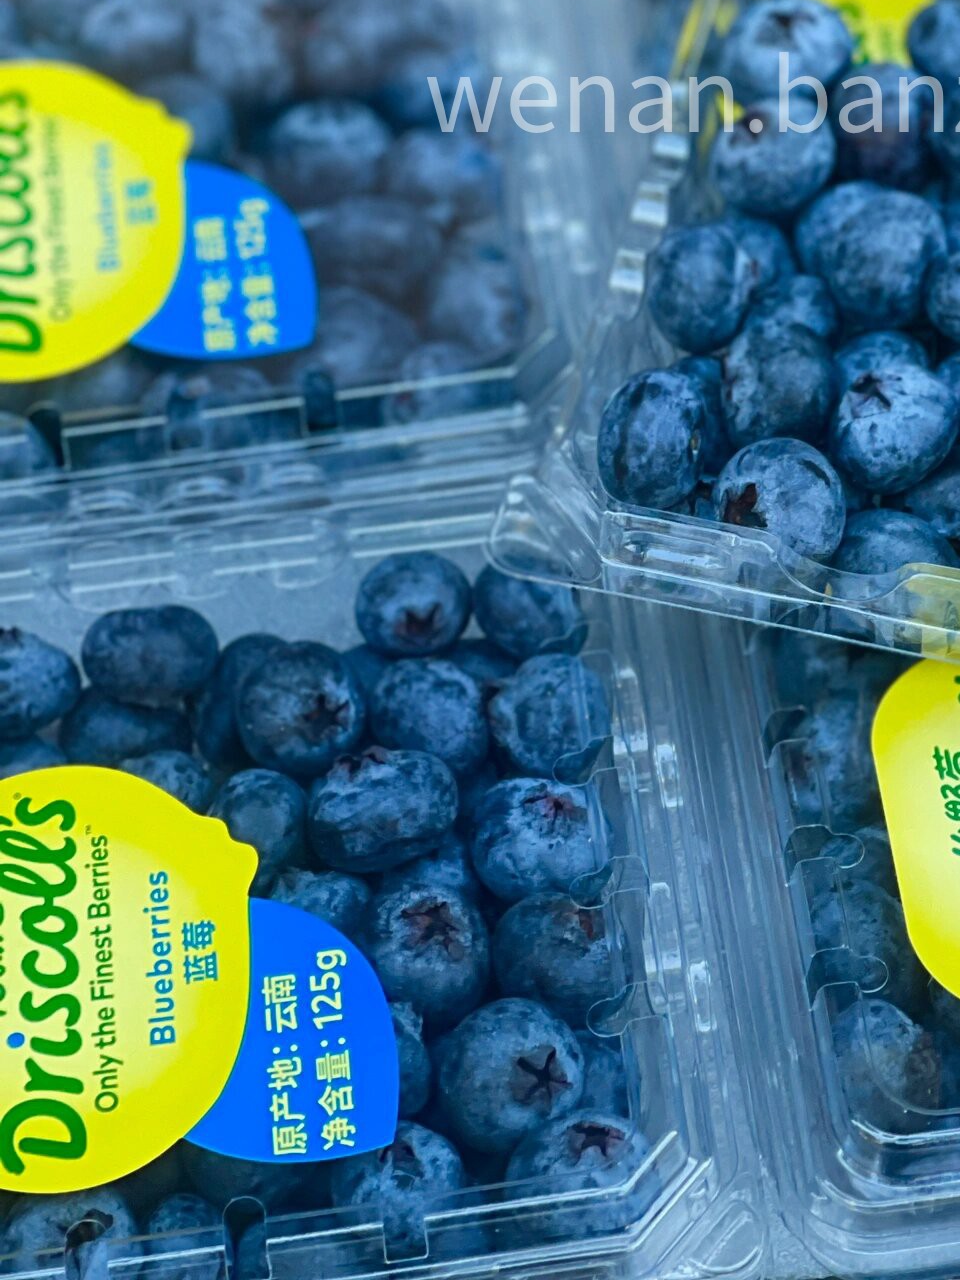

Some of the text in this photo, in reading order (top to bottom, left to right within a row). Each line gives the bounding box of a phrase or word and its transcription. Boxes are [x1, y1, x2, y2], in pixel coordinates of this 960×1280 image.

[89, 924, 114, 1002] Finest
[143, 870, 176, 1046] Blueberries
[182, 920, 218, 984] 蓝莓
[91, 1006, 116, 1050] the
[92, 1054, 124, 1113] Only
